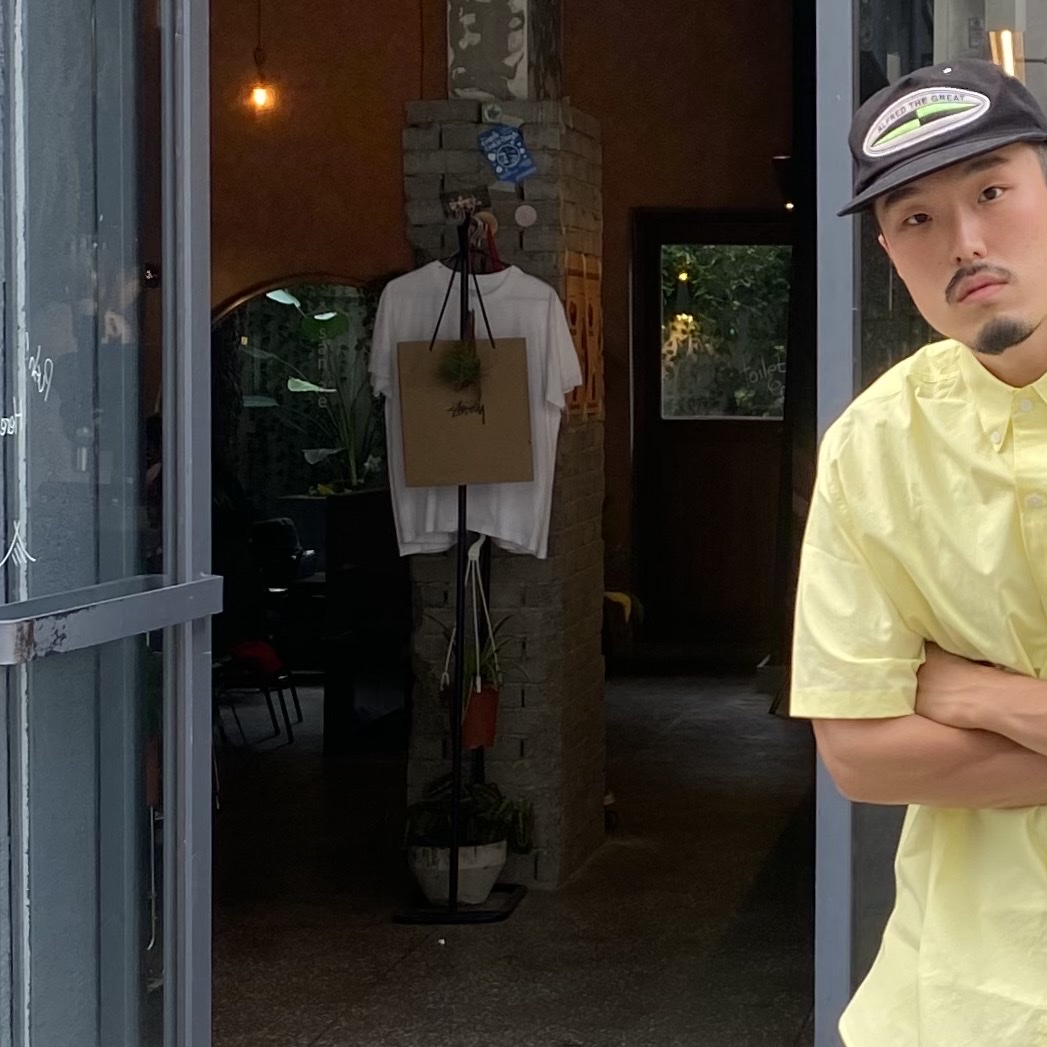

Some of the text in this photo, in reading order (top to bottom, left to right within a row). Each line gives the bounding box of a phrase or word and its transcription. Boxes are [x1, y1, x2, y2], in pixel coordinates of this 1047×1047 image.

[877, 93, 966, 132] ALFRED THE GREAT
